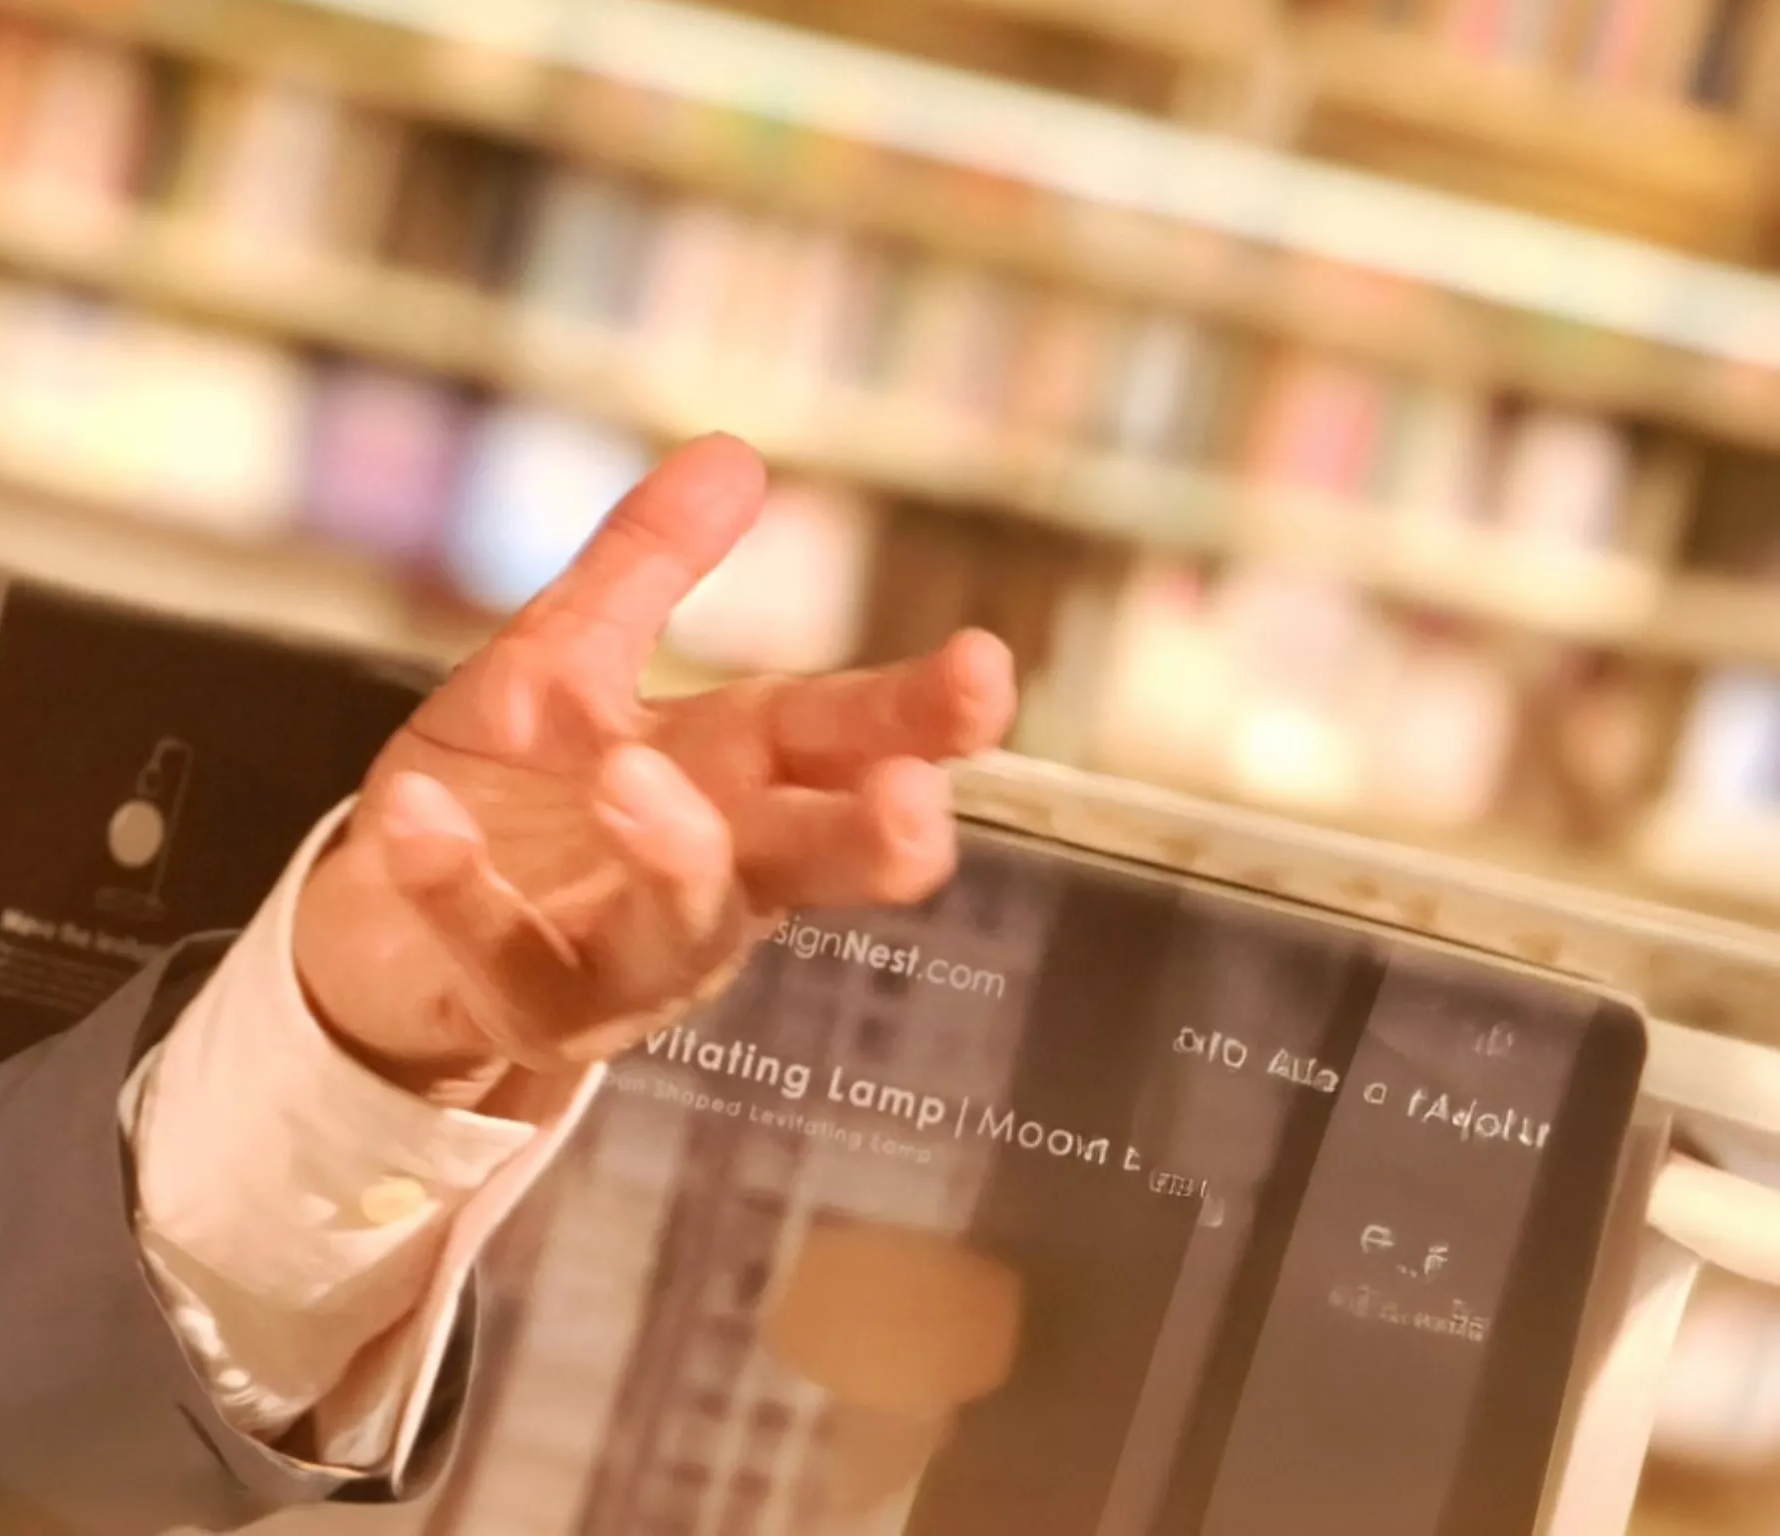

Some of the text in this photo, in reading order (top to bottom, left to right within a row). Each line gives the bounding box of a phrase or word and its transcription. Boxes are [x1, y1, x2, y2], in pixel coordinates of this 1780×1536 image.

[772, 914, 1007, 1000] signNest.com
[645, 1025, 812, 1100] vitating
[827, 1066, 947, 1131] Lamp
[748, 1103, 863, 1152] Levitating
